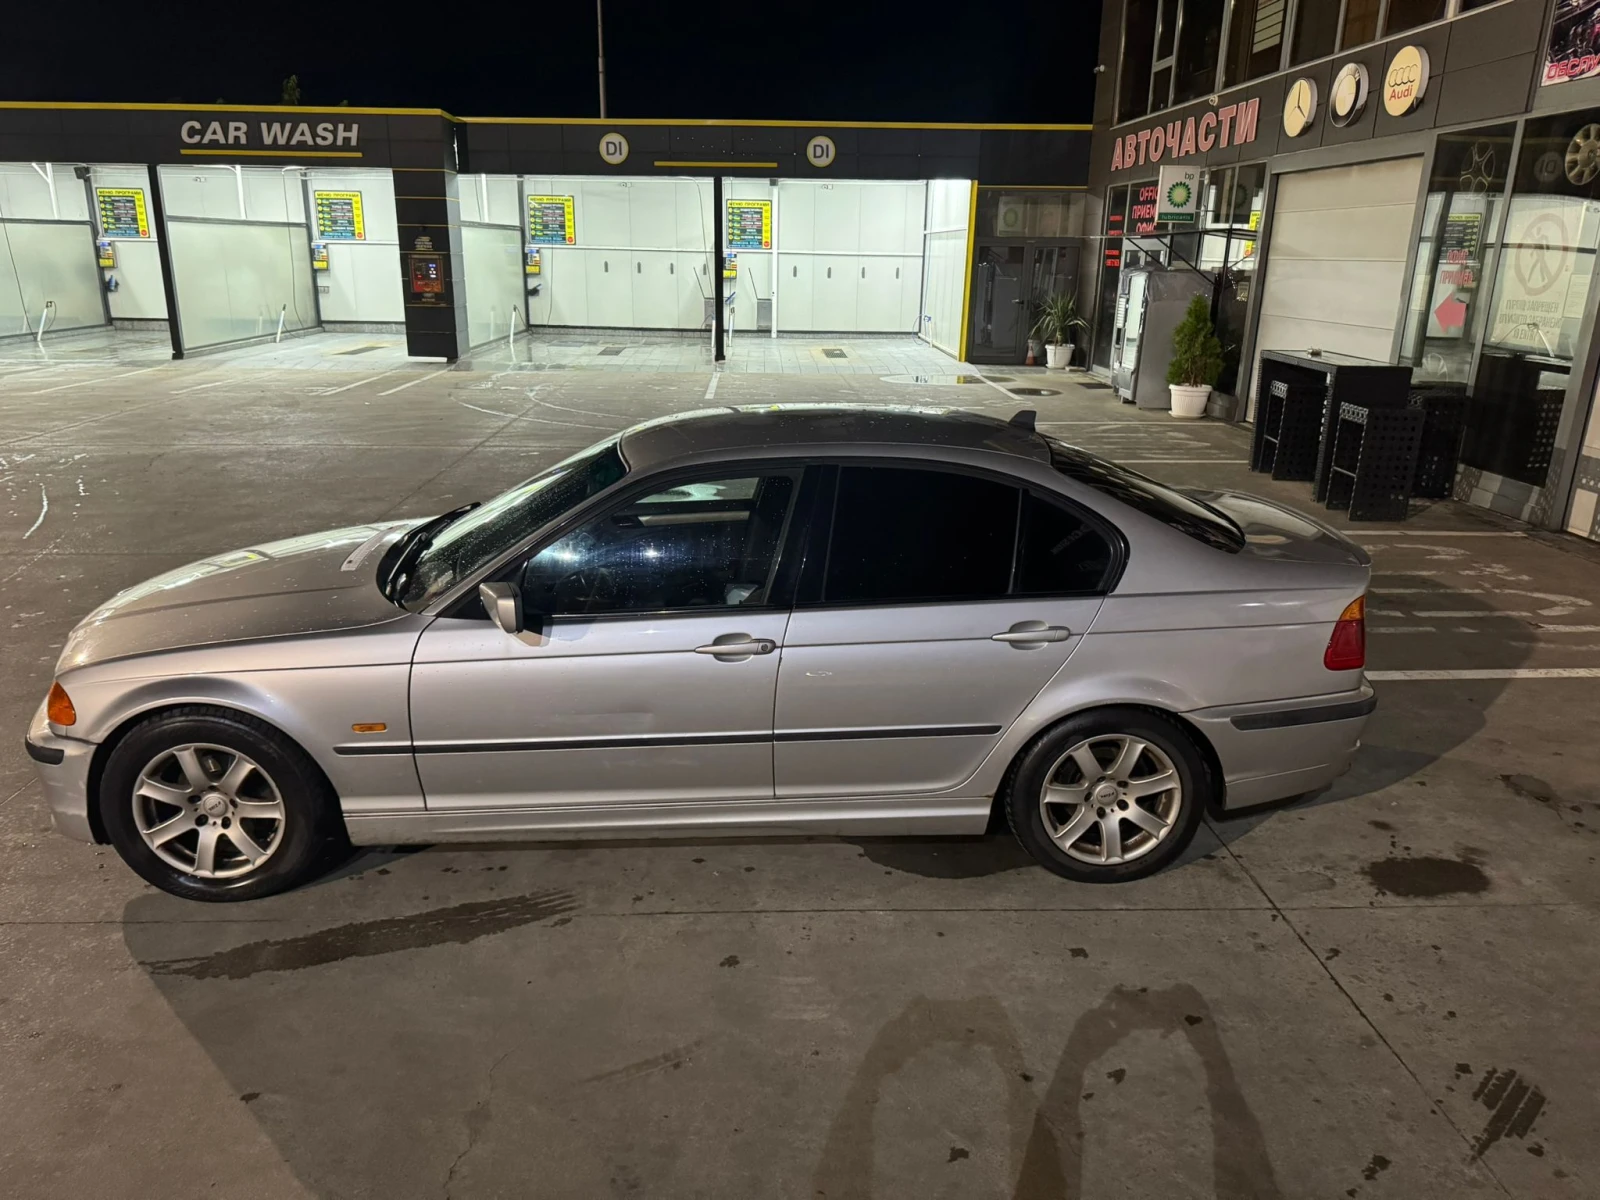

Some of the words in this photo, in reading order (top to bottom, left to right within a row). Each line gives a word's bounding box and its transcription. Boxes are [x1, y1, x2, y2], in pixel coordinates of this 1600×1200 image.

[1388, 84, 1413, 101] Audi
[180, 120, 248, 145] CAR
[260, 122, 359, 146] WASH
[1110, 97, 1260, 172] АВТОЧАСТИ
[605, 141, 623, 156] DI
[813, 144, 829, 159] DI
[1184, 171, 1195, 181] bp
